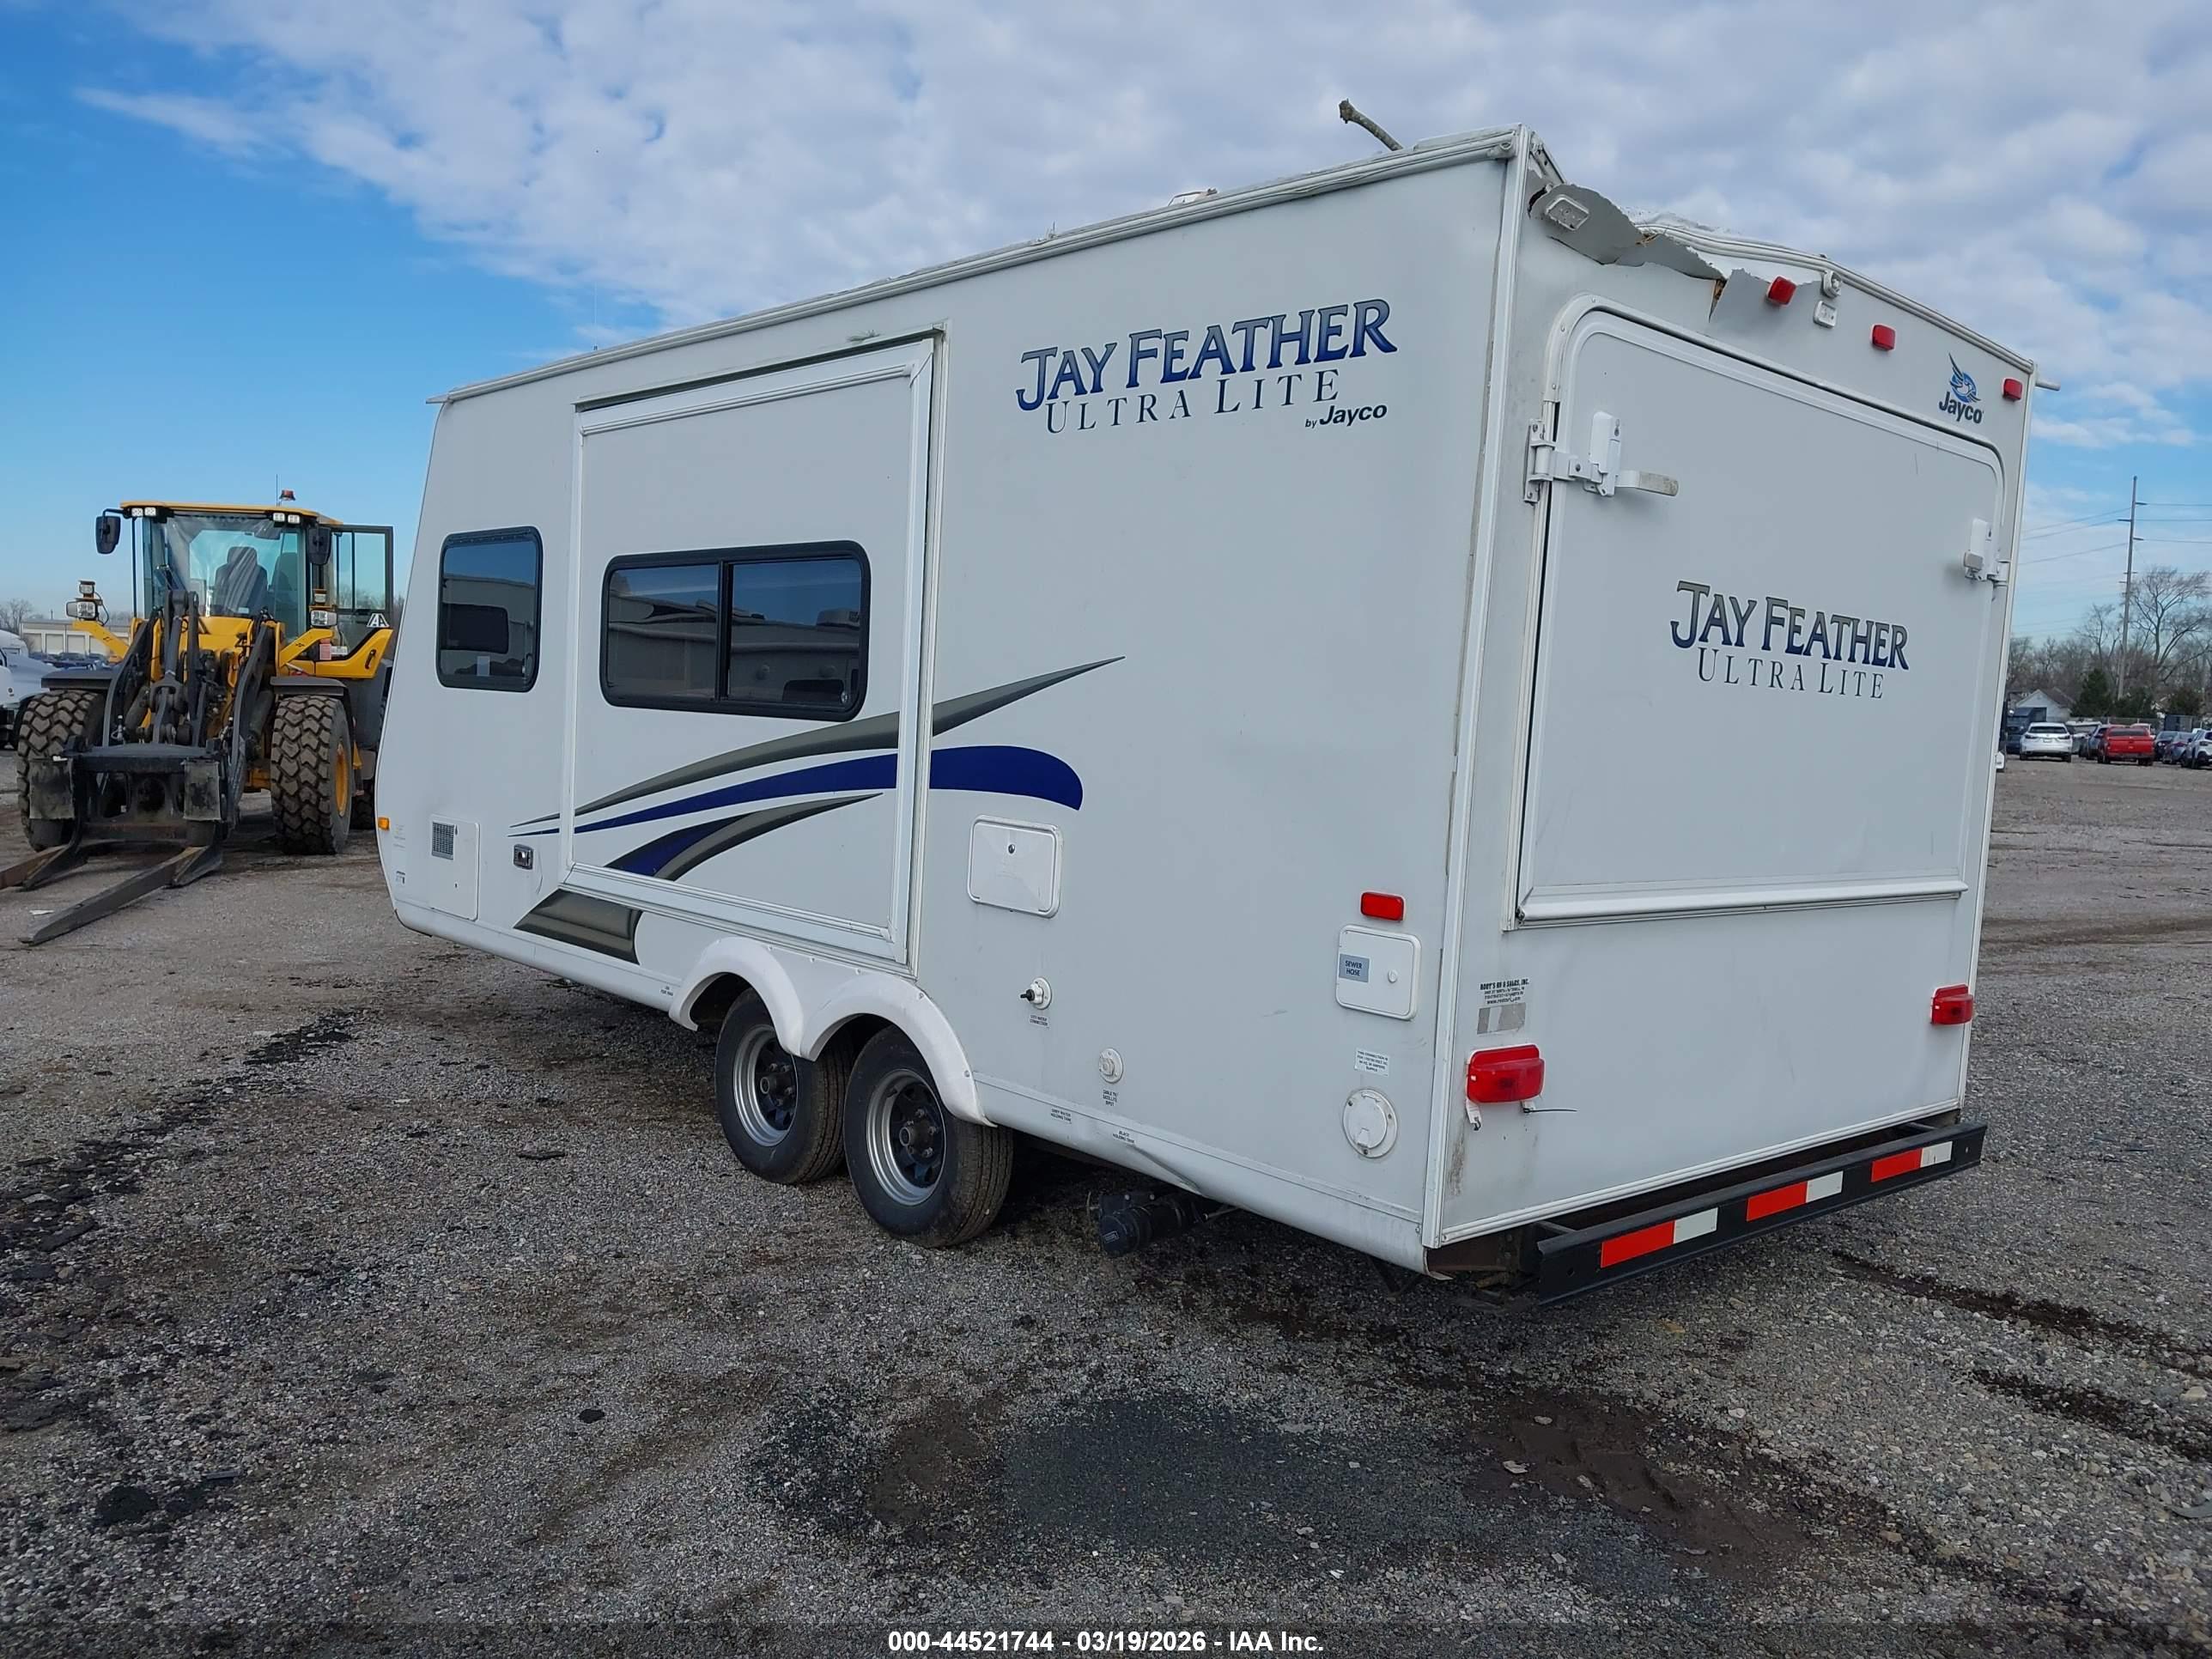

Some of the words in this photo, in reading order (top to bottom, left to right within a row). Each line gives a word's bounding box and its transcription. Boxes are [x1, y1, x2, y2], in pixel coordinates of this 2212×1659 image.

[1016, 342, 1117, 411] JAY
[1126, 298, 1398, 388] FEATHER
[1046, 389, 1192, 434] ULTRA
[1213, 369, 1340, 415] LITE
[1305, 418, 1318, 429] by
[1319, 404, 1388, 428] Jayco
[1938, 391, 1983, 424] Jayco
[1670, 580, 1758, 649] JAY
[1761, 597, 1910, 671] FEATHER
[1698, 647, 1805, 691] ULTRA
[1817, 662, 1885, 699] LITE
[1345, 960, 1363, 969] SEWER
[1346, 968, 1361, 976] HOSE
